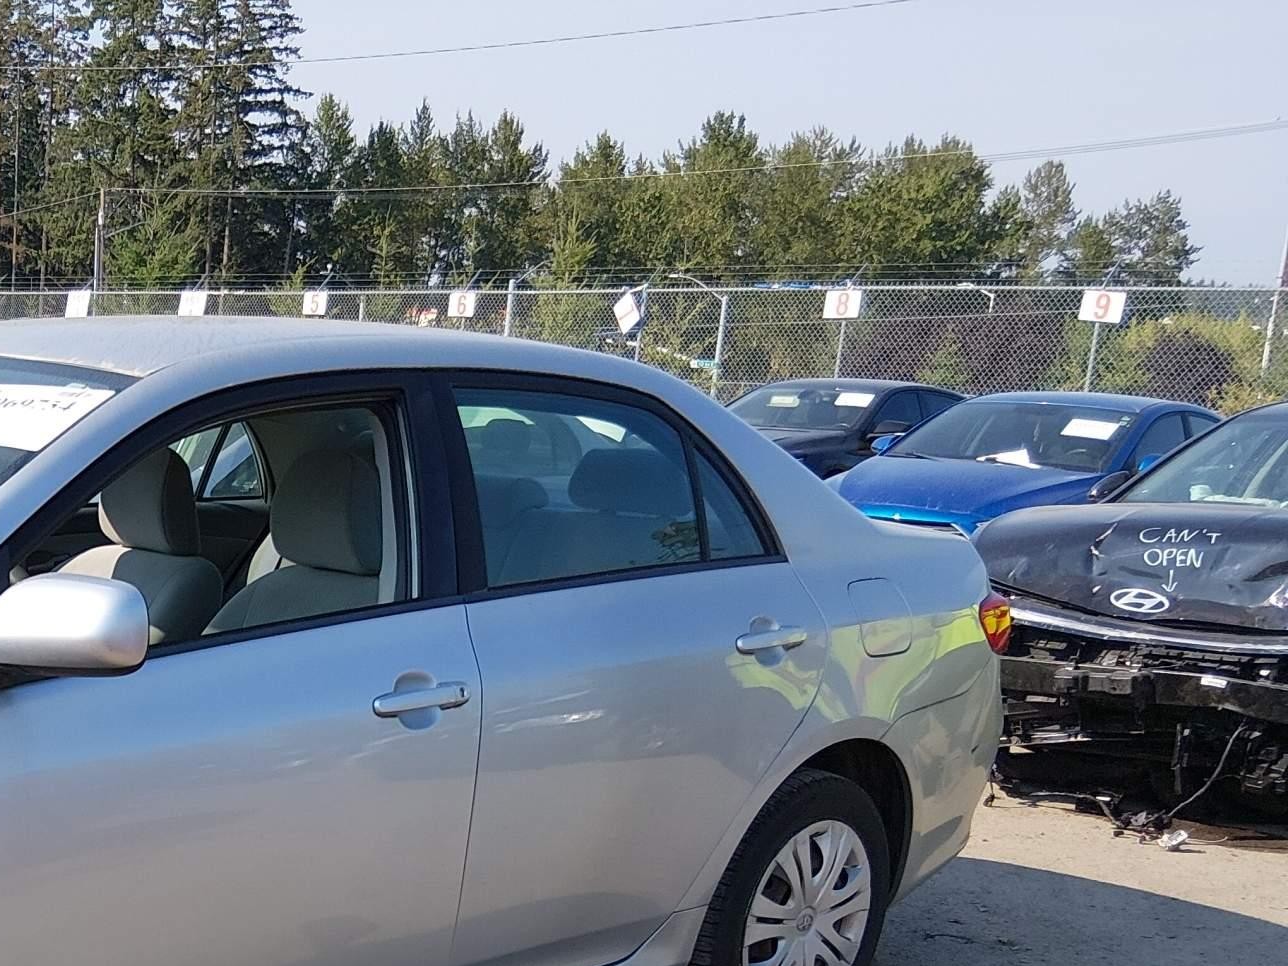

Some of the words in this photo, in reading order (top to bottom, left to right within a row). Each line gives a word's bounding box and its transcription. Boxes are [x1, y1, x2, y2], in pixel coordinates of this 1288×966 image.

[310, 294, 320, 314] 5
[456, 294, 467, 316] 6
[835, 292, 850, 317] 8
[1093, 292, 1112, 320] 9
[1138, 526, 1223, 546] CAN'T
[1142, 547, 1205, 569] OPEN
